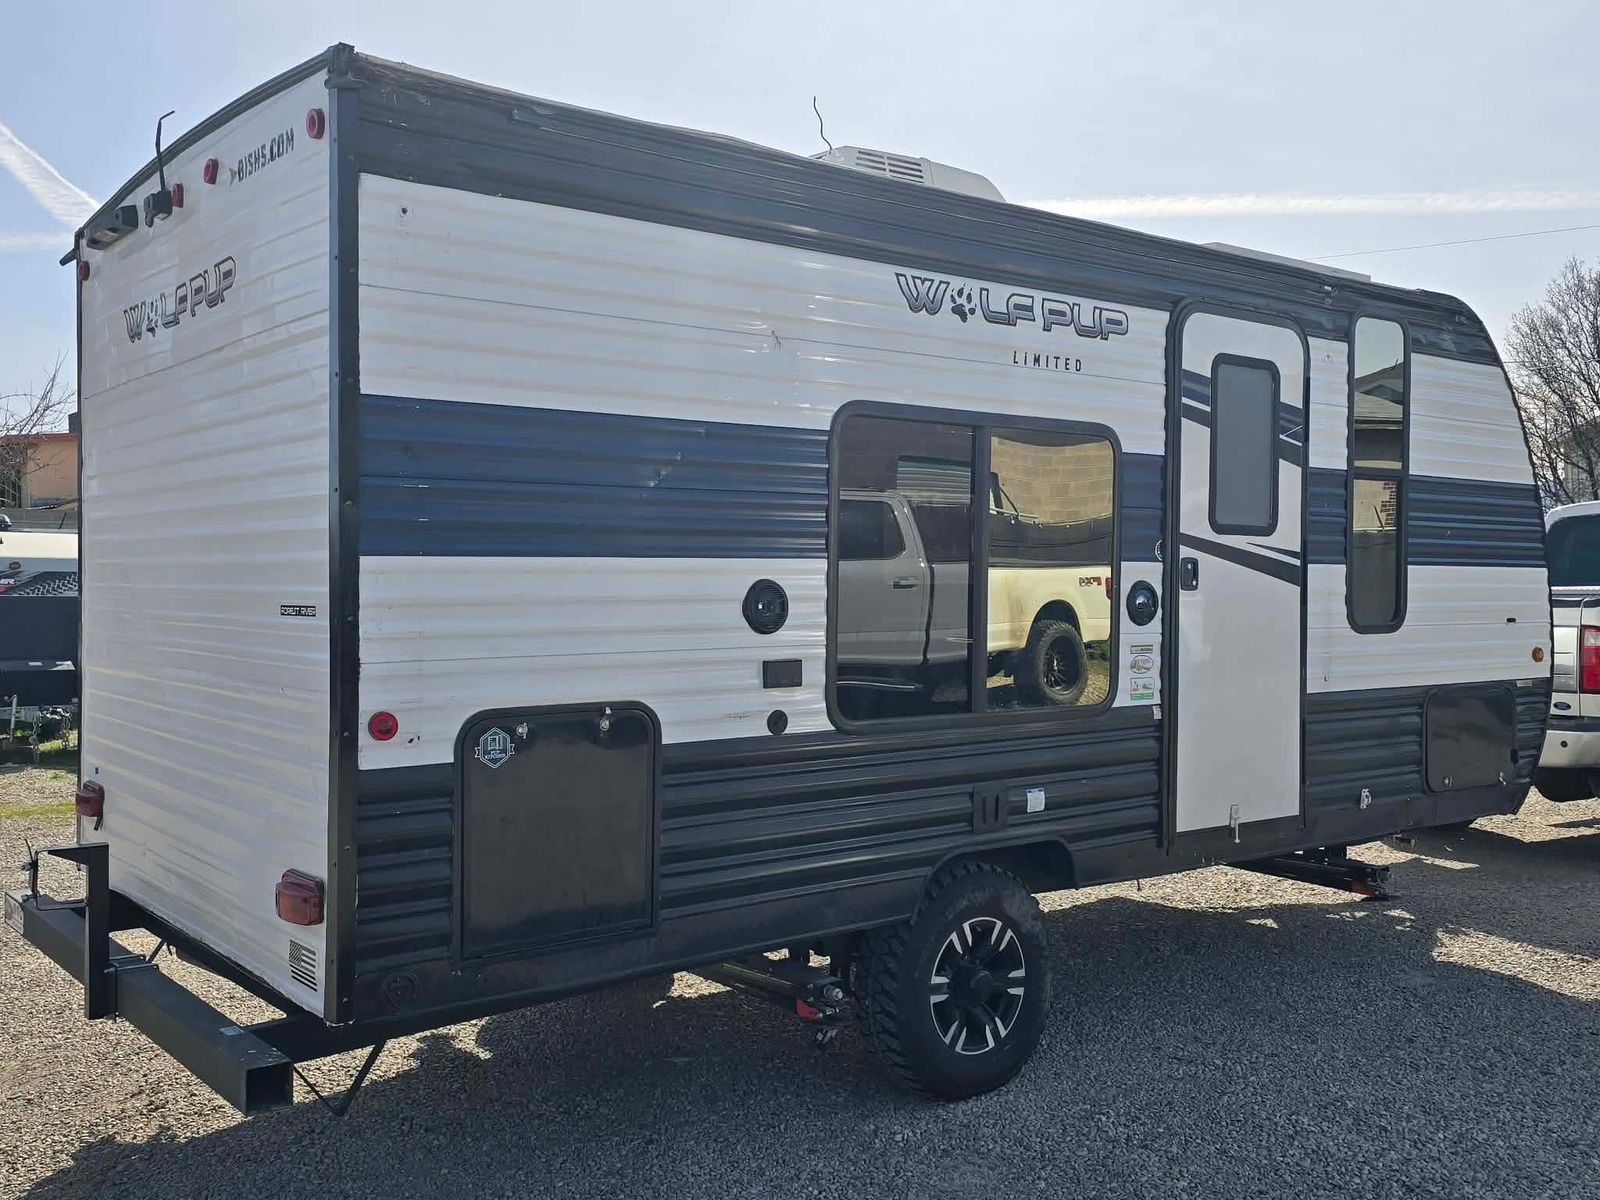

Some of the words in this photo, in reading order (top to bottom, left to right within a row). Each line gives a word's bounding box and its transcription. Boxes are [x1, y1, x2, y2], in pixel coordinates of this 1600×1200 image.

[238, 128, 295, 183] BISHS.COM
[190, 256, 237, 318] PUP
[1042, 298, 1129, 341] PUP
